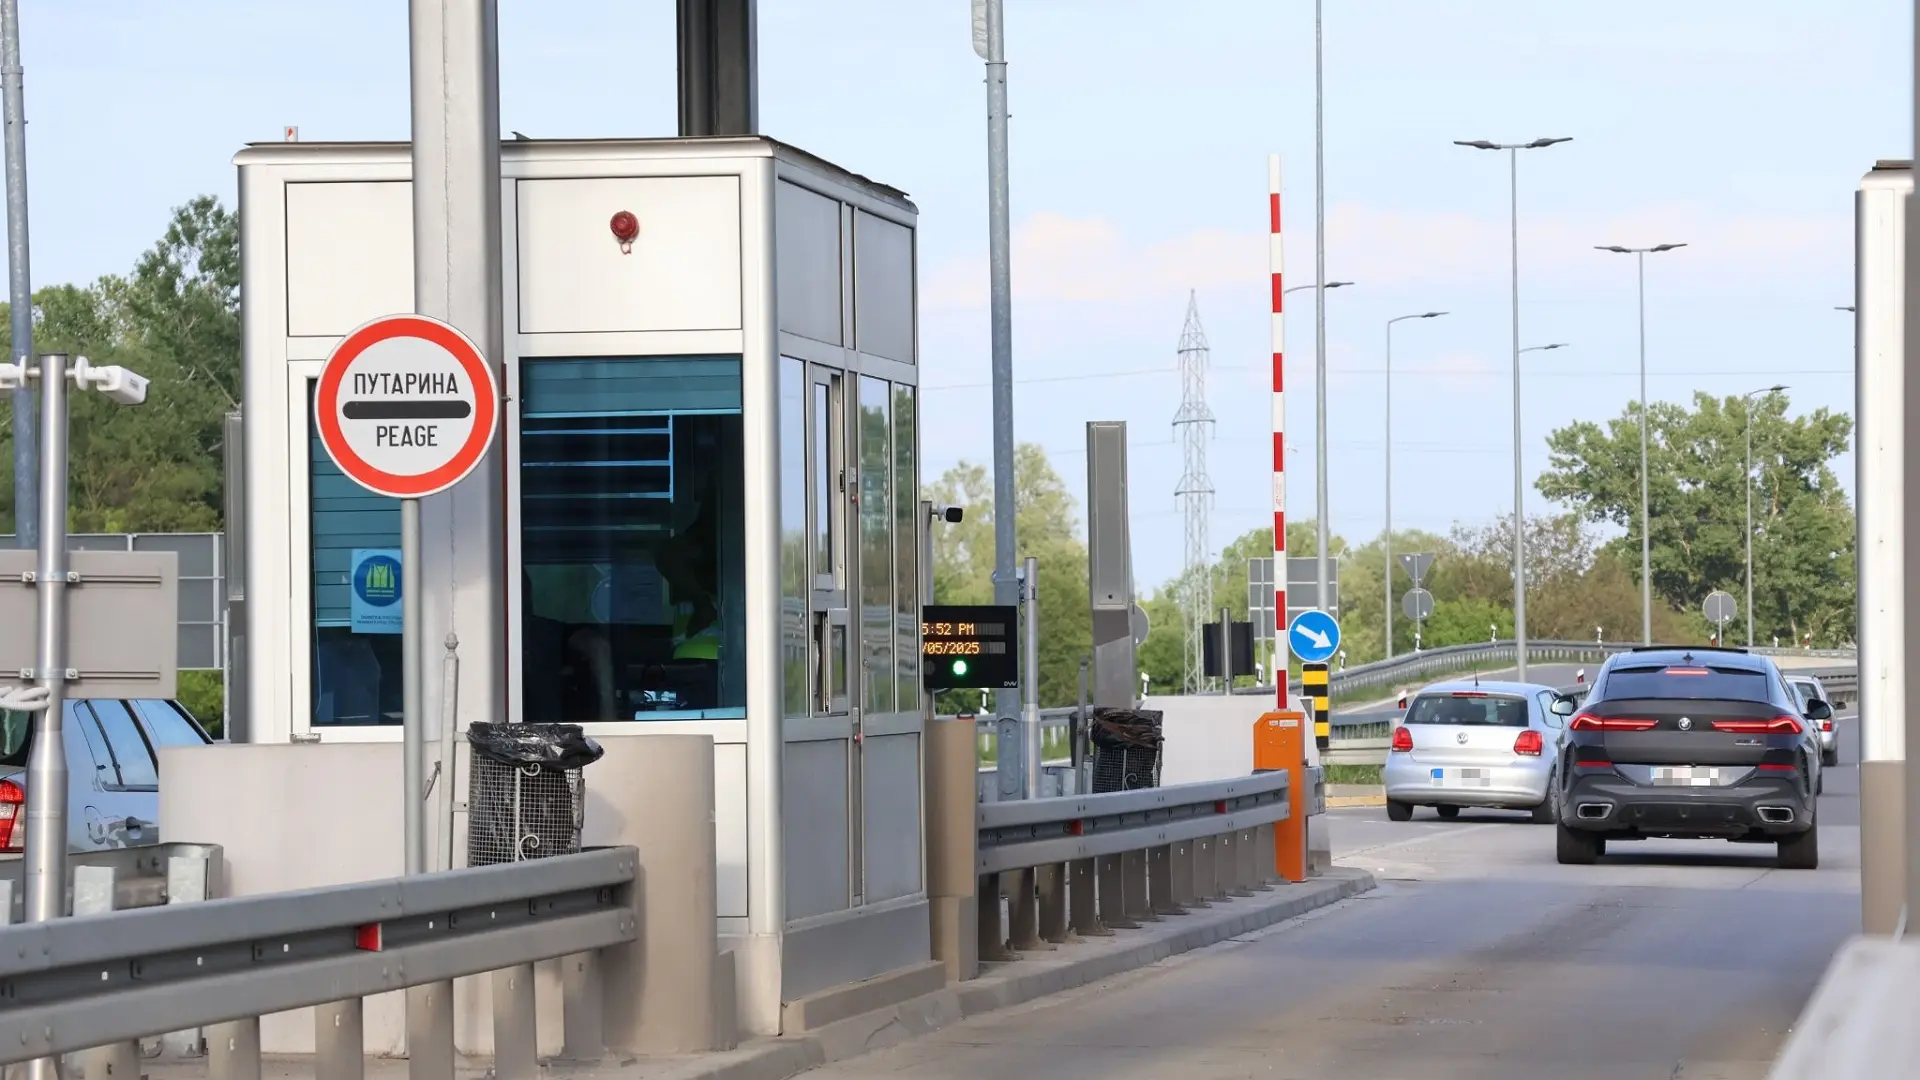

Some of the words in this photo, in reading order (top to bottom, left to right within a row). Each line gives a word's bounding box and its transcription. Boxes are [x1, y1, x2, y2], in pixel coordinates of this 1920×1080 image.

[354, 373, 459, 394] ПУТАРИНА
[376, 426, 438, 446] PEAGE
[958, 623, 974, 635] PM
[922, 642, 980, 654] /05/2025
